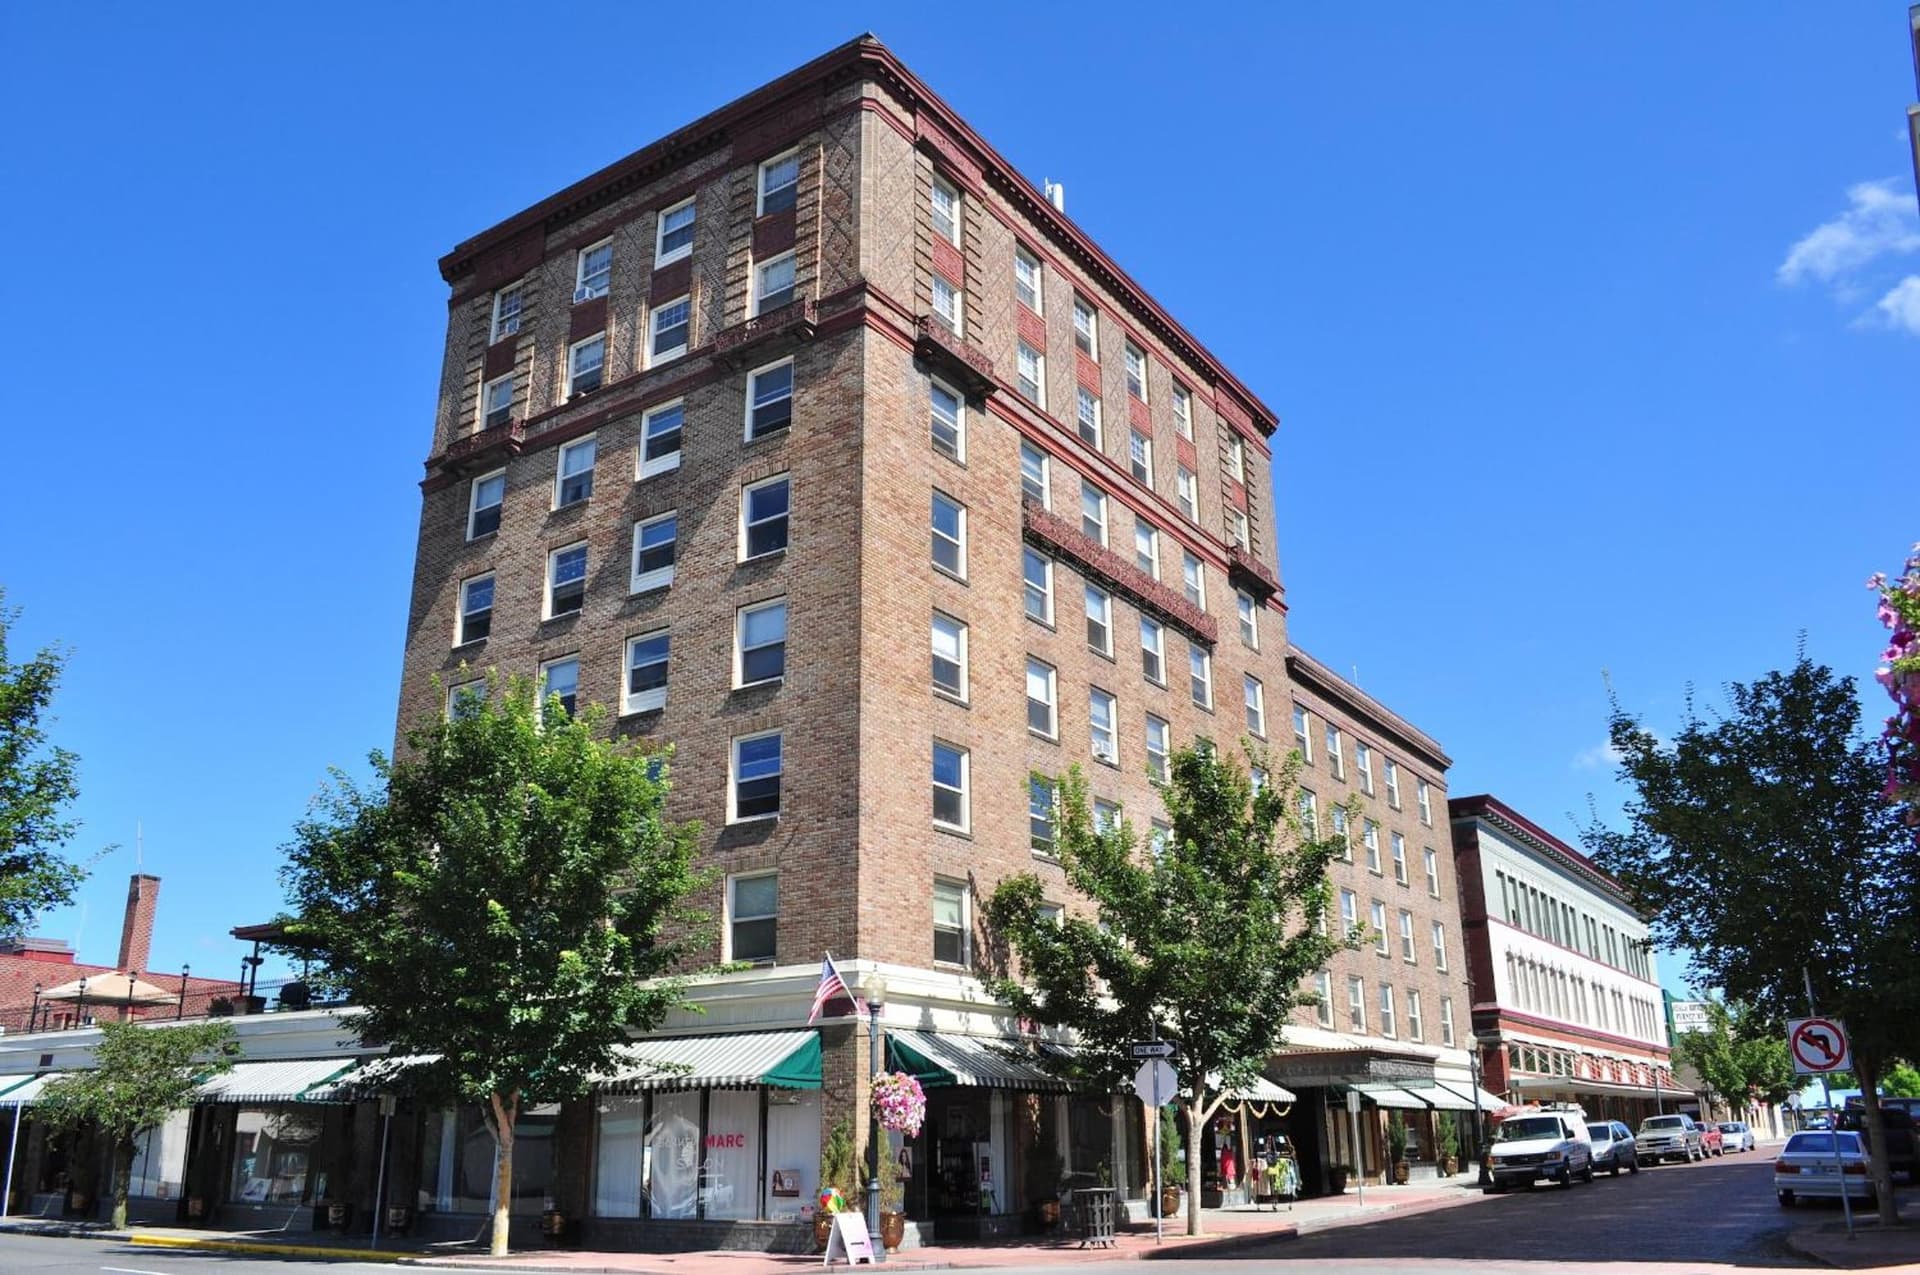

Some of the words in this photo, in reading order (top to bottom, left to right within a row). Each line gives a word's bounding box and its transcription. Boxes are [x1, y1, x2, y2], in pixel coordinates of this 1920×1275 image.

[1134, 1046, 1147, 1054] ONE
[1150, 1046, 1163, 1054] WAY
[703, 1133, 745, 1148] MARC
